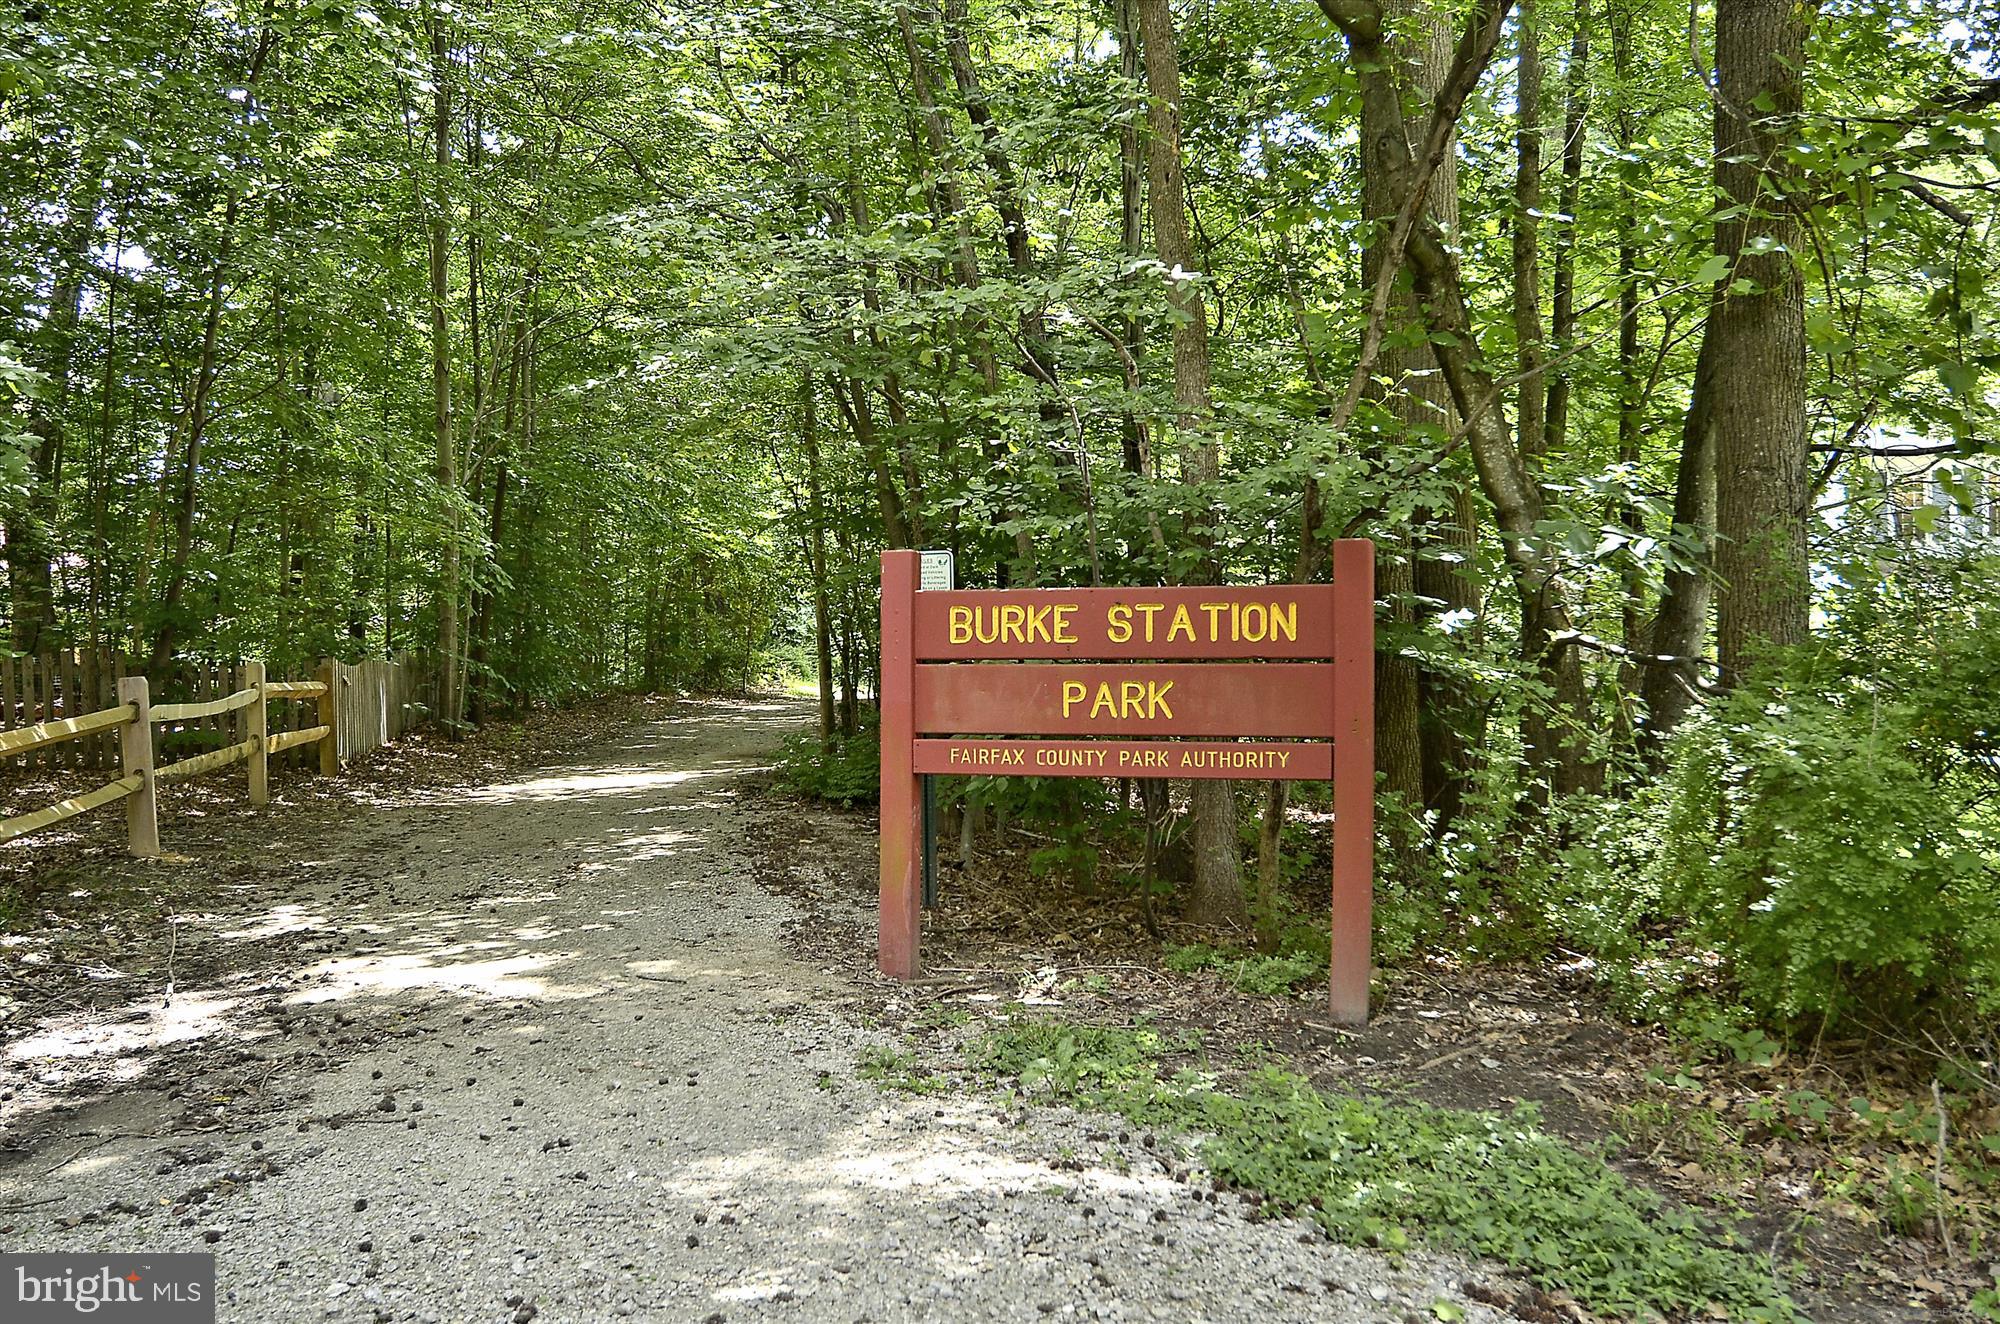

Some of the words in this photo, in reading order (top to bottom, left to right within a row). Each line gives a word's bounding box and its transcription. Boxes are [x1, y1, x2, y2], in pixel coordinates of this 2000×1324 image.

[948, 602, 1079, 645] BURKE
[1106, 601, 1298, 644] STATION
[1062, 680, 1175, 720] PARK
[949, 748, 1025, 766] FAIRFAX
[1036, 749, 1108, 767] COUNTY
[1119, 750, 1170, 768] PARK
[1181, 750, 1291, 769] AUTHORITY
